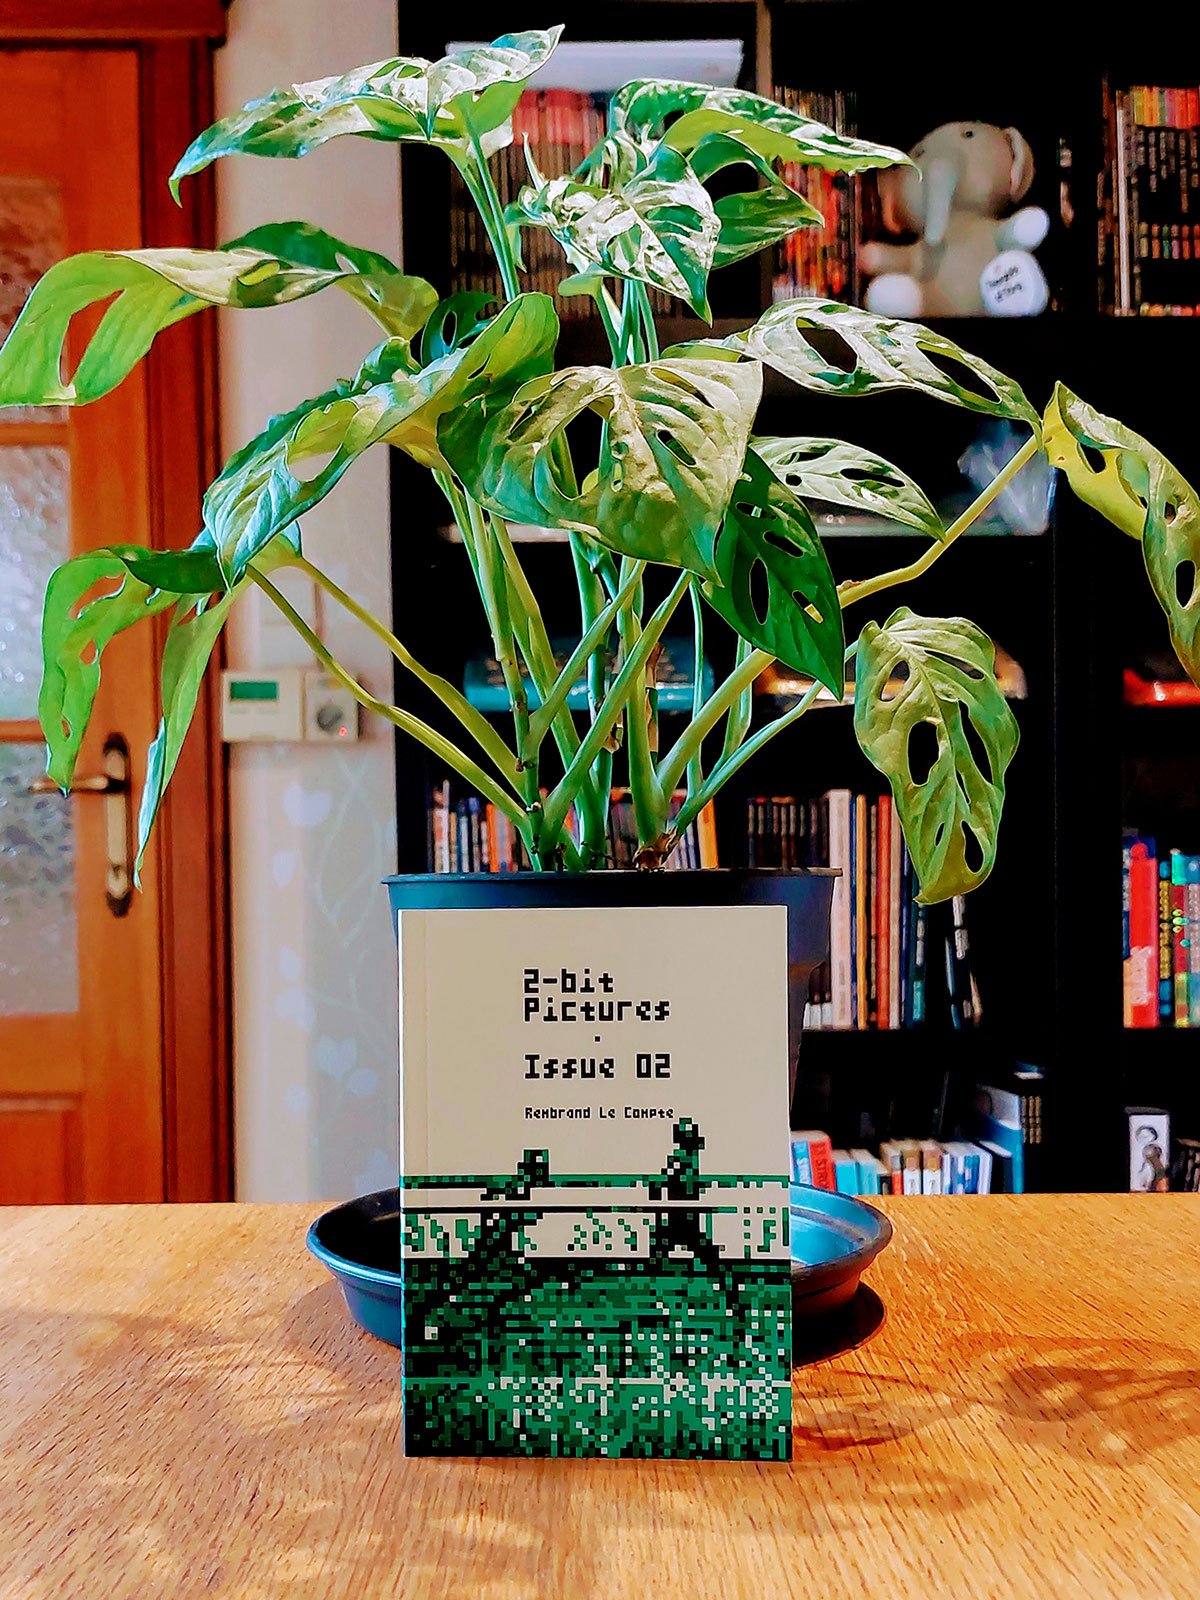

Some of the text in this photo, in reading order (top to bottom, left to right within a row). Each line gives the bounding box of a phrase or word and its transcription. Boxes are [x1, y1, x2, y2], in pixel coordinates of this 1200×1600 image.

[523, 968, 614, 994] 2-bit
[524, 997, 671, 1022] Pictures
[524, 1053, 671, 1080] Issue 02
[525, 1106, 675, 1119] Rembrand Le Compte
